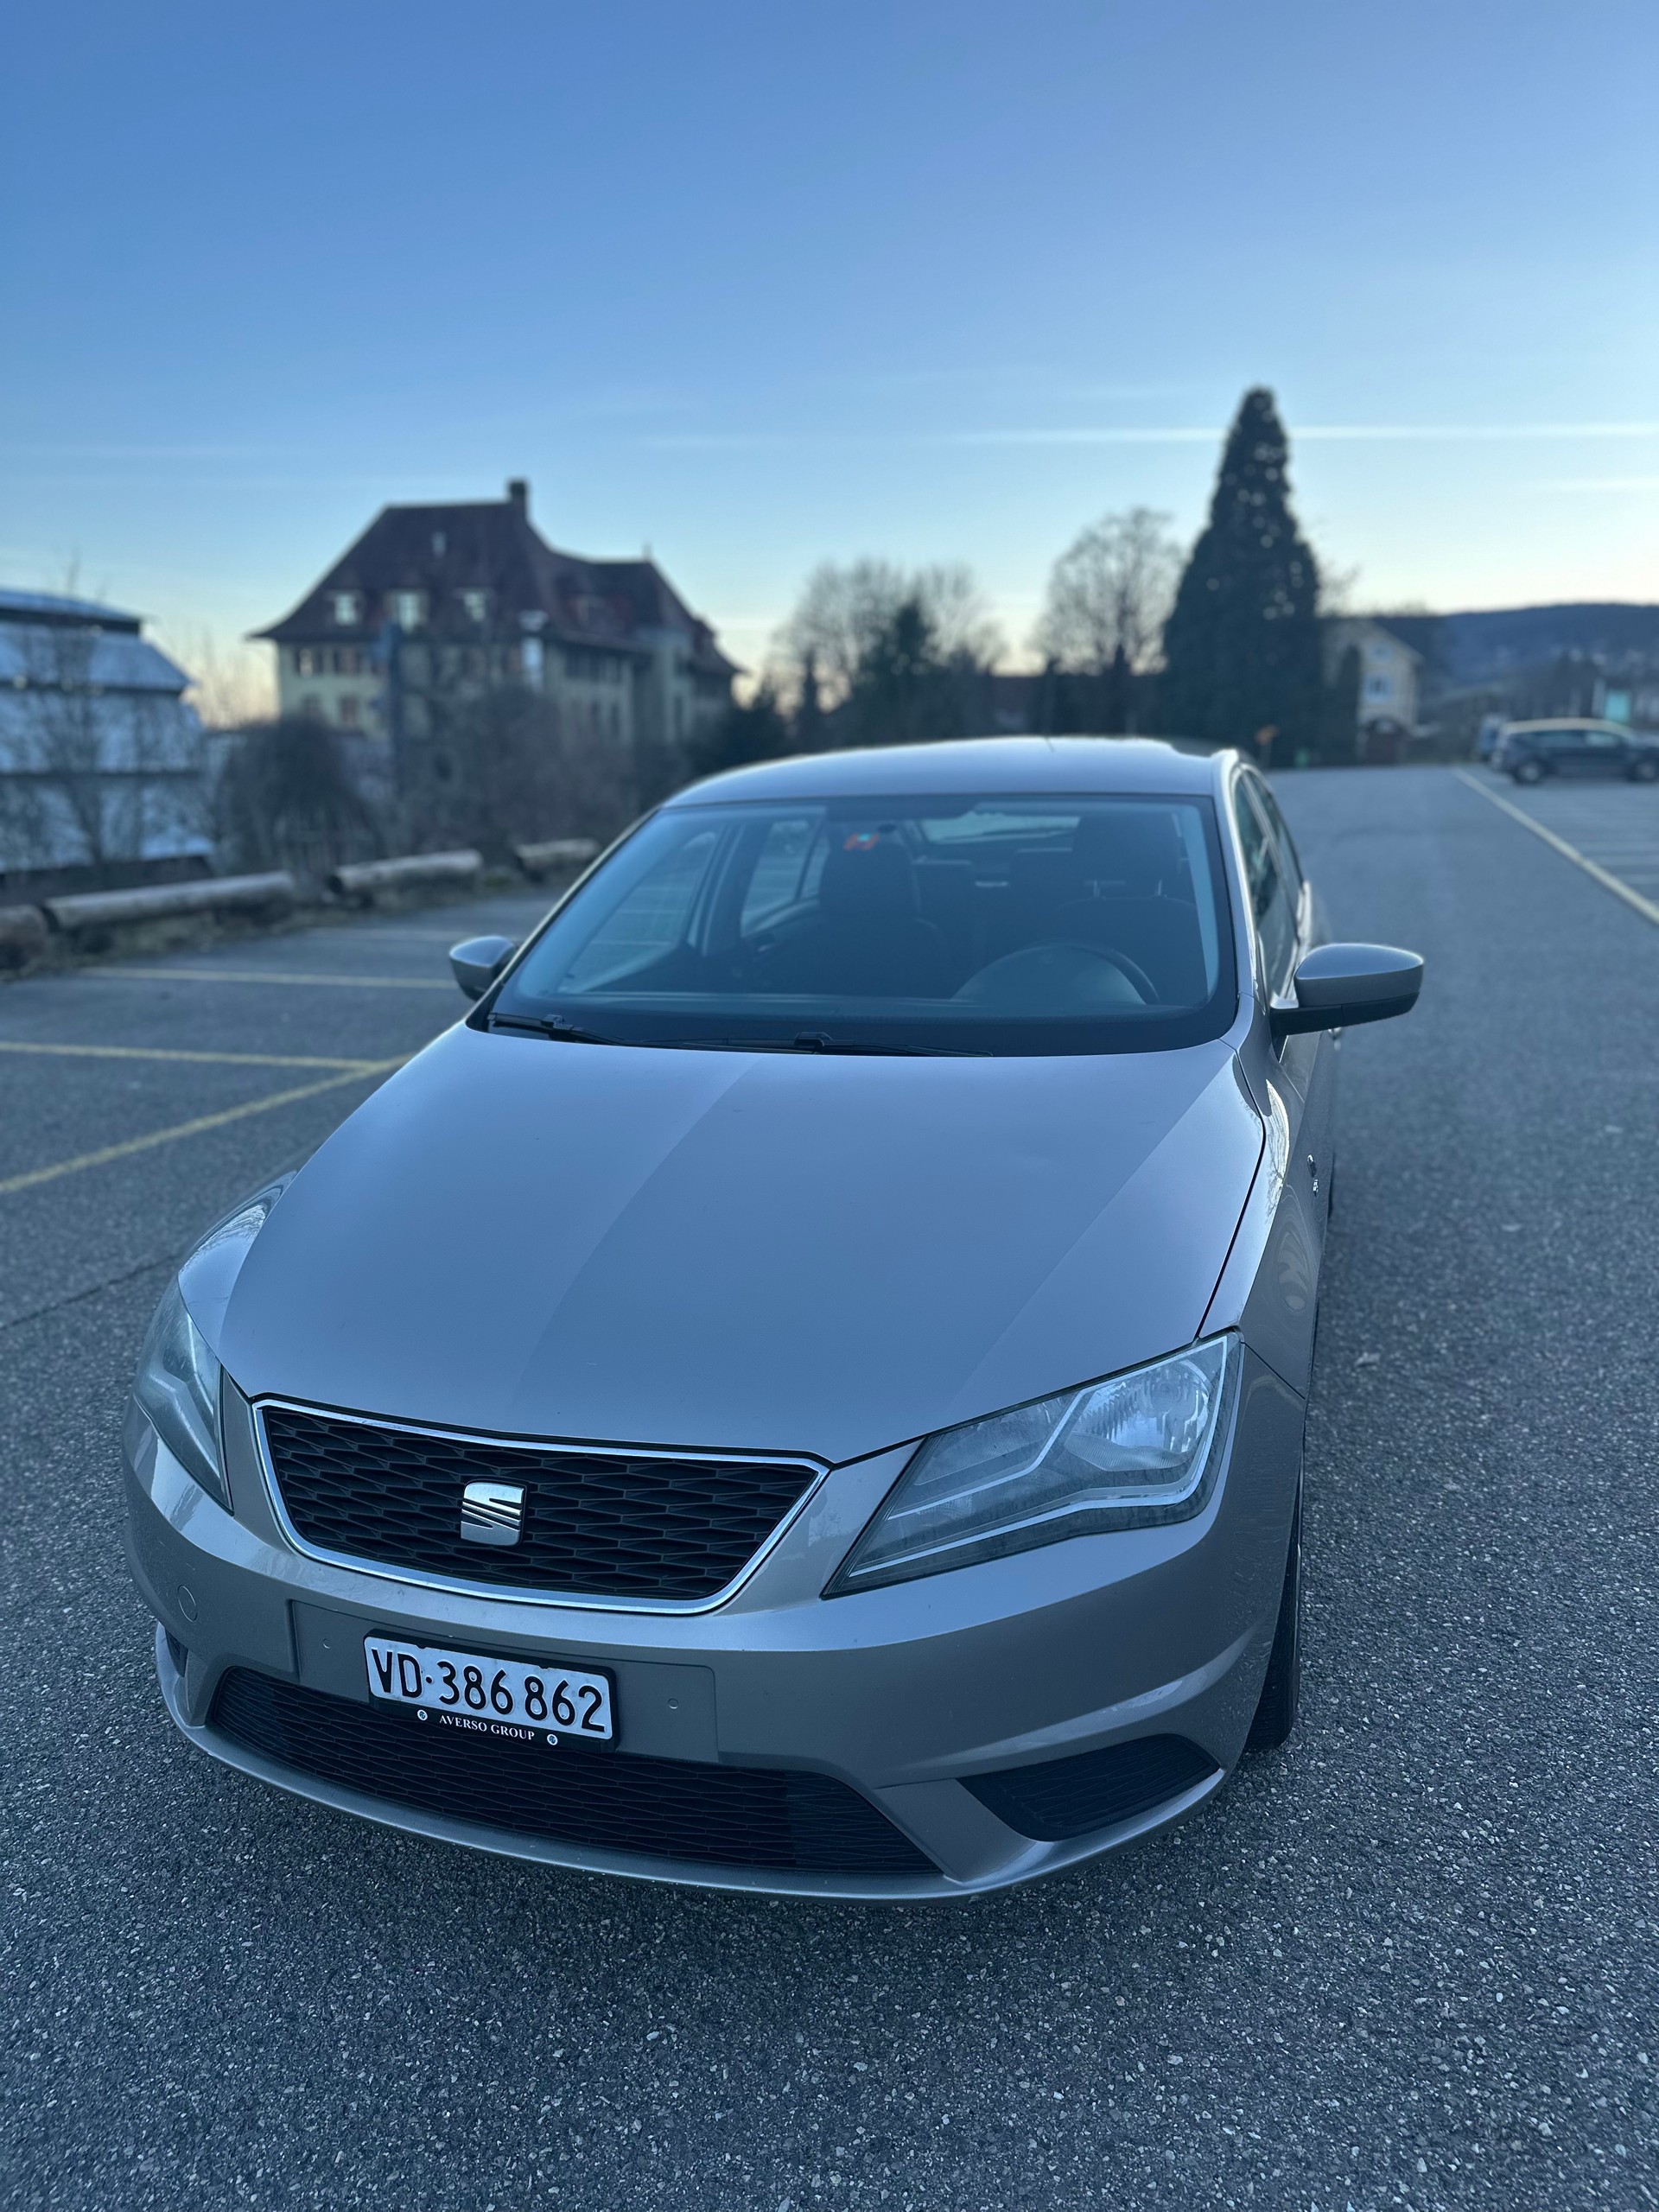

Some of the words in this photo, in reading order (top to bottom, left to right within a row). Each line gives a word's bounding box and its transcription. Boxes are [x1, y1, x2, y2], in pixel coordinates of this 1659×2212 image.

[524, 1675, 605, 1732] 862
[439, 1715, 487, 1732] AVERSO
[491, 1725, 535, 1740] GROUP
